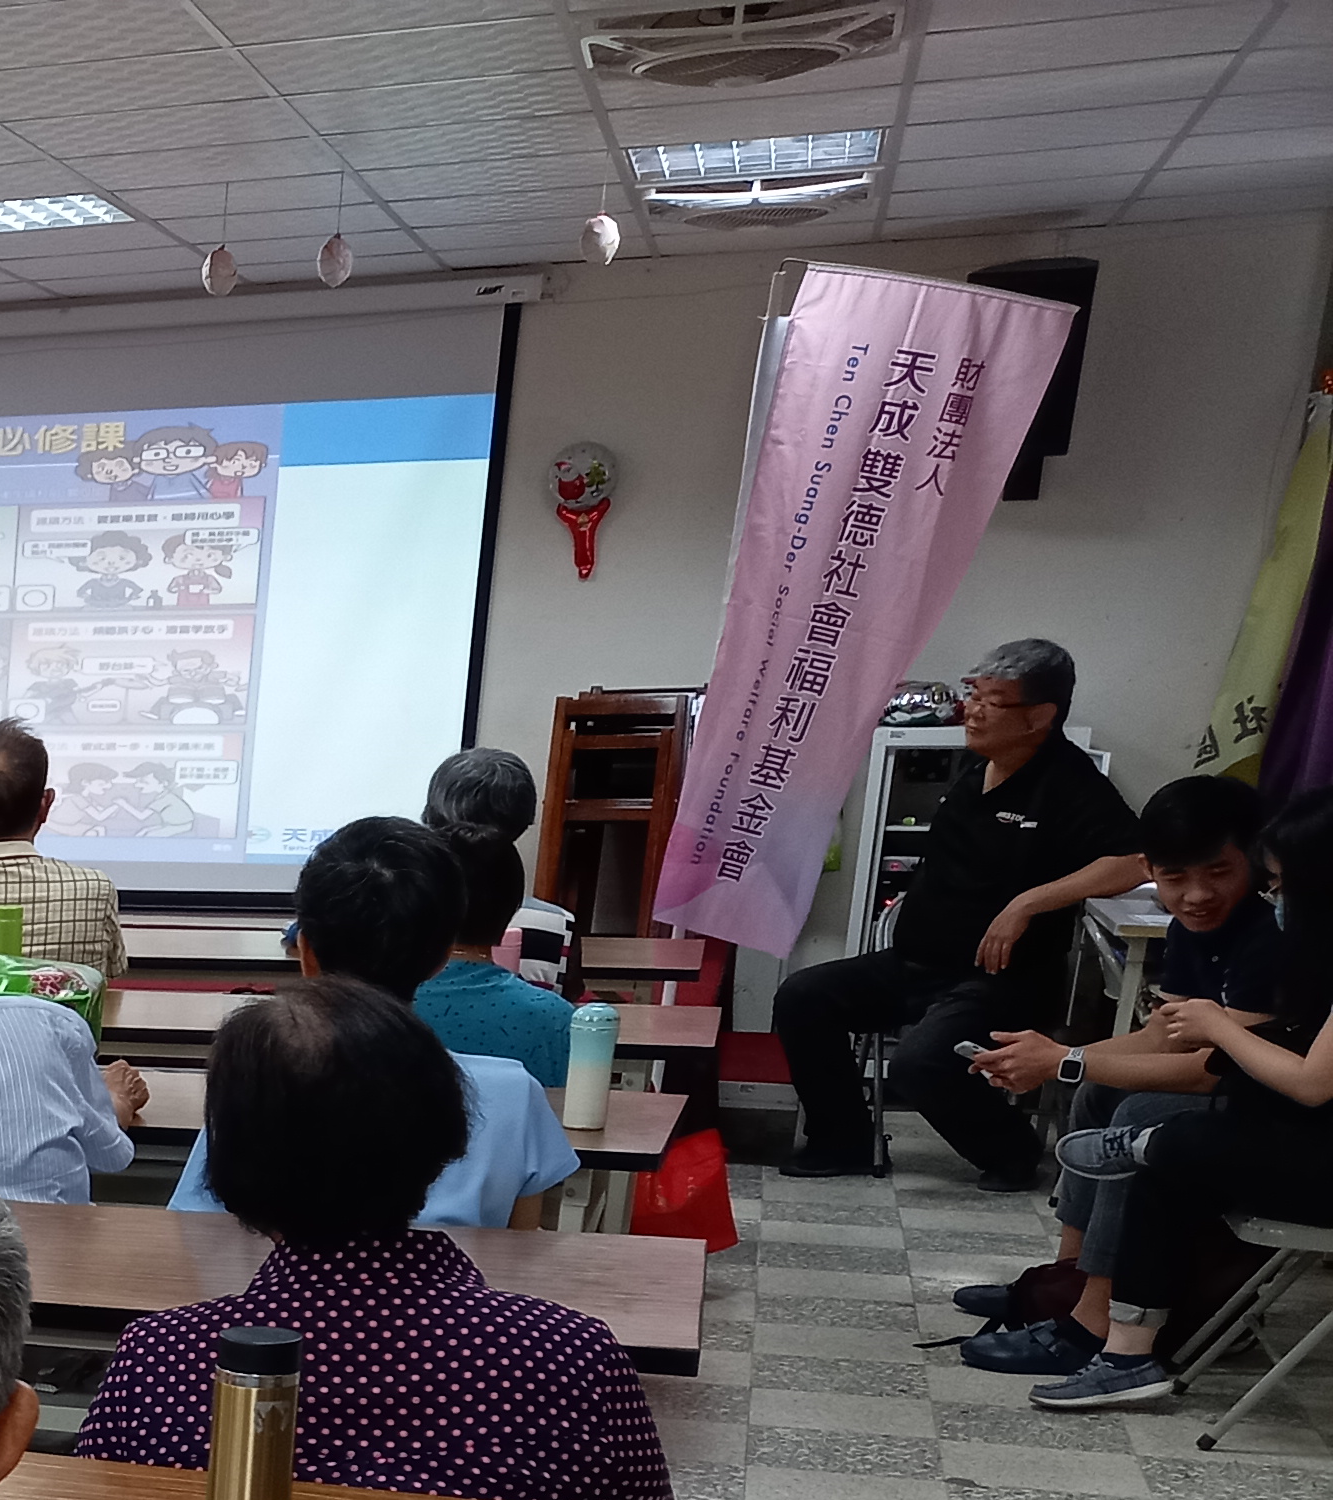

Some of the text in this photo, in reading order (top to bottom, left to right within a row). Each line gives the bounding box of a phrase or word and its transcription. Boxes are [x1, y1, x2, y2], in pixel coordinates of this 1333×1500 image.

[842, 343, 870, 383] Ten
[820, 394, 853, 449] Chen
[915, 357, 986, 497] 財團法人
[784, 460, 832, 574] Suang-Der
[766, 584, 790, 647] Social
